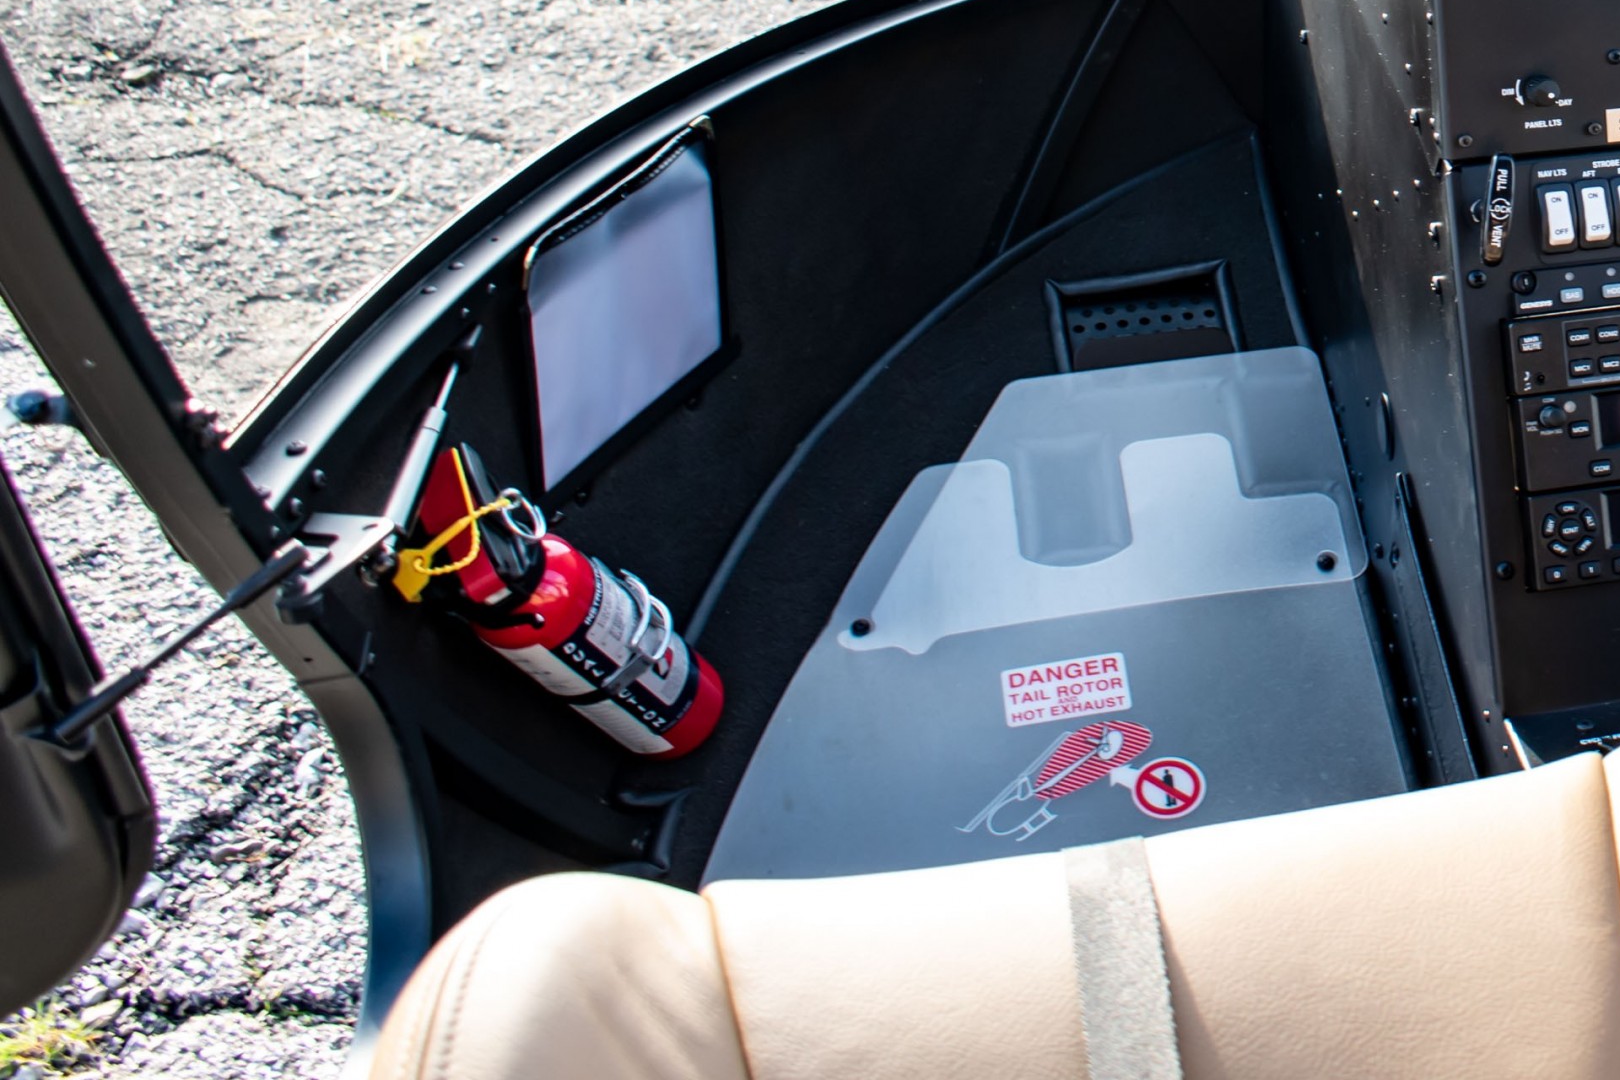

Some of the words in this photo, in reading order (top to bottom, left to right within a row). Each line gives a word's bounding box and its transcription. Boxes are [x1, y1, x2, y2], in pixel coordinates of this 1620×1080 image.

[1525, 121, 1547, 129] PANEL
[1548, 119, 1562, 127] LTS
[1538, 170, 1553, 178] NAV
[1592, 159, 1620, 168] STROBE
[1497, 169, 1508, 191] PULL
[1491, 225, 1503, 247] VENT
[1008, 657, 1119, 689] DANGER
[1009, 687, 1051, 705] TAIL
[1057, 677, 1123, 698] ROTOR
[1058, 696, 1078, 704] AND
[618, 689, 667, 728] CTION
[1011, 708, 1045, 722] HOT
[1050, 695, 1125, 717] EXHAUST
